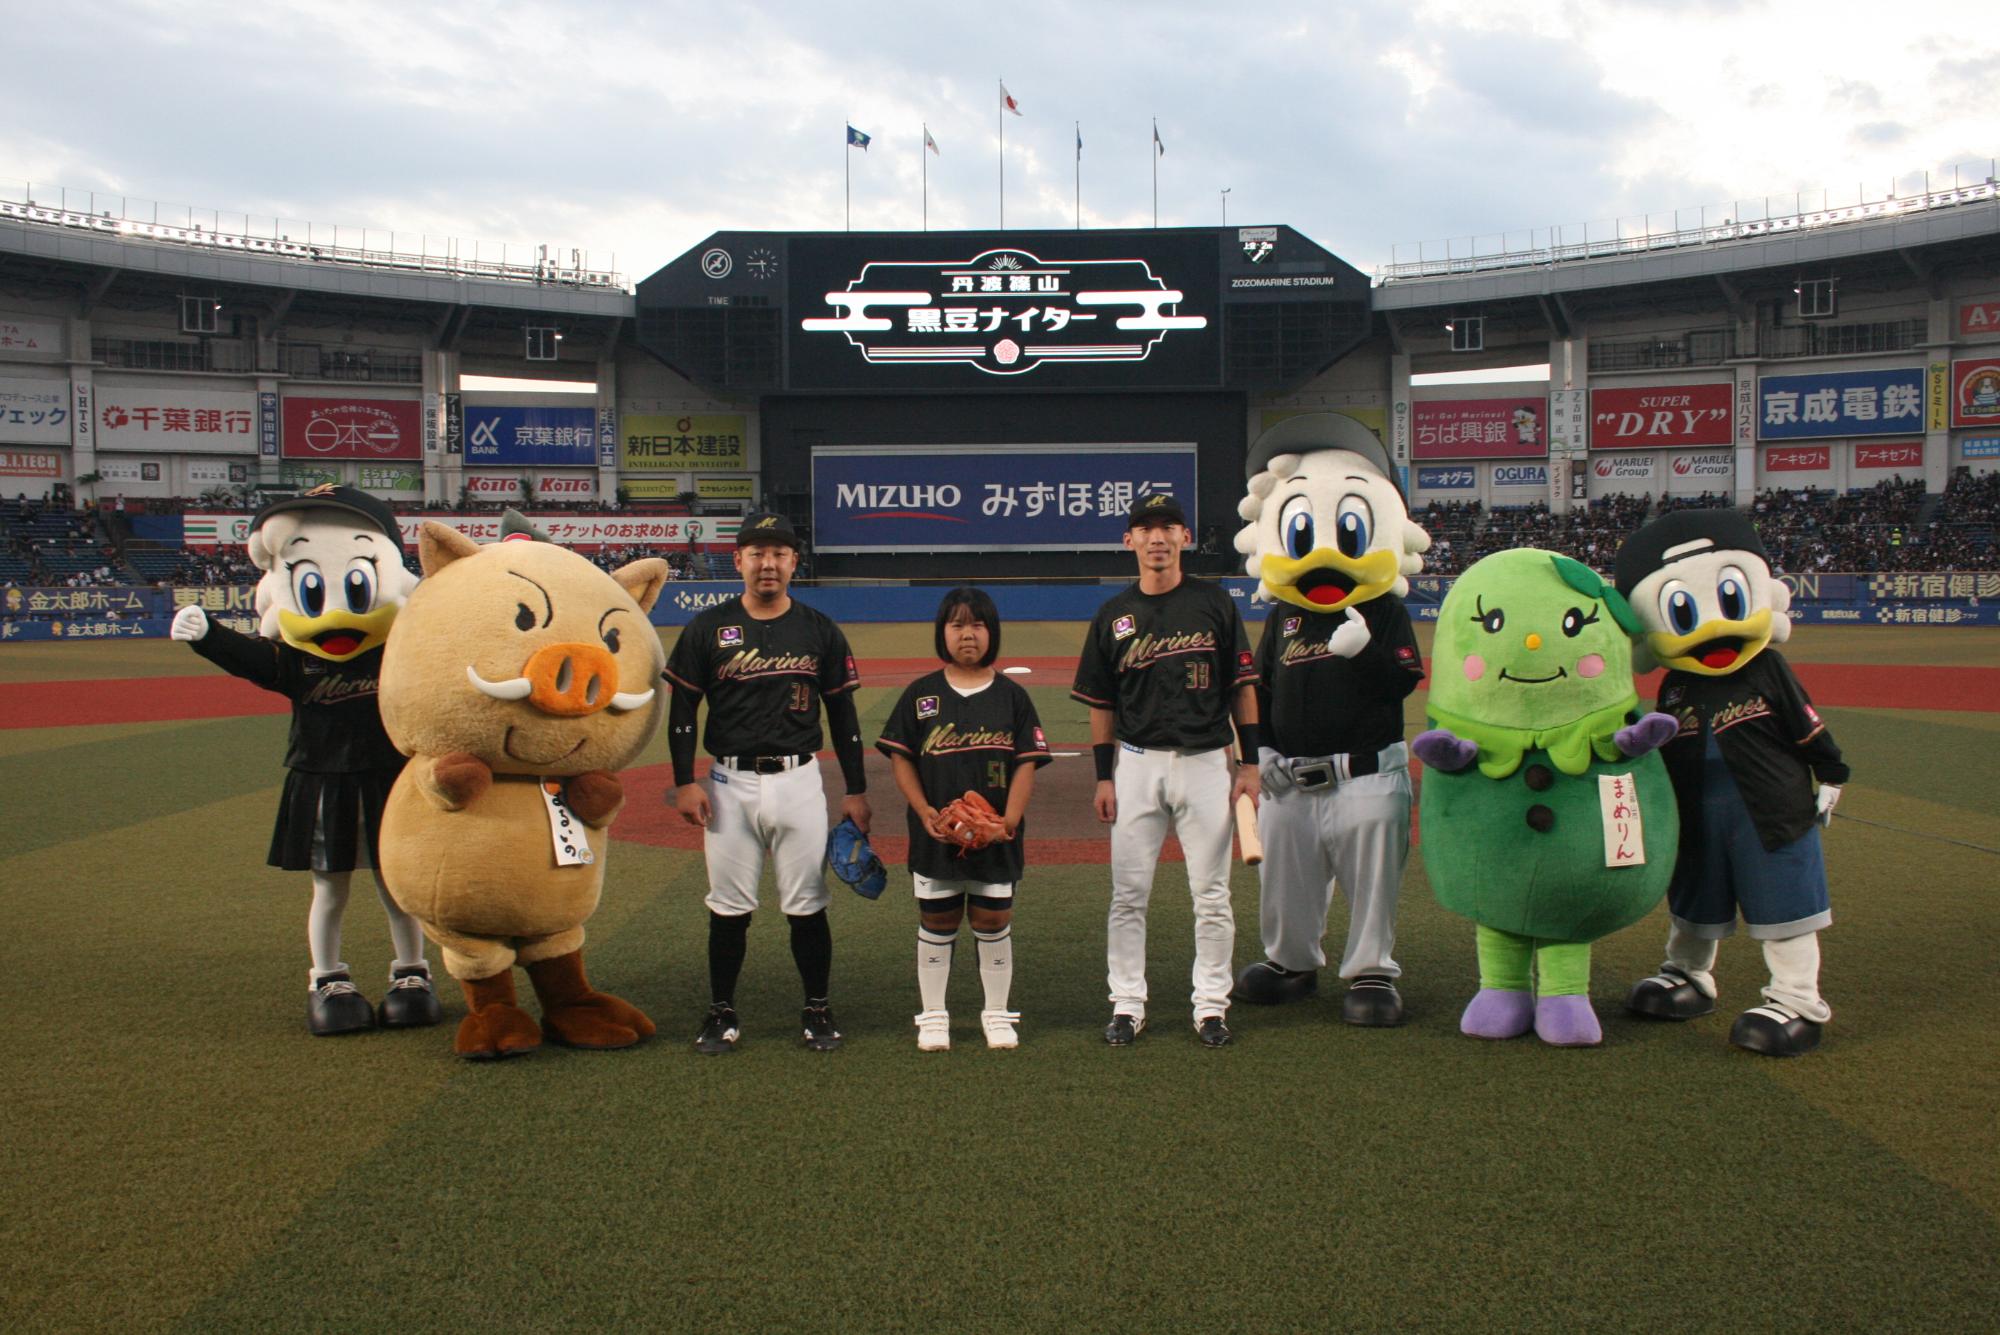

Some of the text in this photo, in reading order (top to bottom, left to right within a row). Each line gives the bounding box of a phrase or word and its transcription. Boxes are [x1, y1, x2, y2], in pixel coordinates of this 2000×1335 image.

[951, 275, 1060, 292] 丹波篠山
[1232, 276, 1334, 287] ZOZOMARINE STADIUM
[708, 296, 729, 305] TIME
[907, 306, 1098, 332] 黒豆ナイター
[1639, 395, 1691, 408] SUPER
[1739, 380, 1752, 426] 京成バス
[1763, 383, 1921, 425] 京成電鉄
[131, 407, 252, 434] 千葉銀行
[447, 394, 460, 453] アーキセプト
[514, 426, 593, 447] 京葉銀行
[1417, 421, 1508, 445] ちば興銀
[471, 446, 499, 455] BANK
[627, 434, 741, 457] 新日本建設
[689, 460, 740, 468] DEVELOPER
[1612, 457, 1654, 466] MARUEI
[1769, 454, 1826, 466] アーキセプト
[1859, 450, 1919, 463] アーキセプト
[1438, 471, 1474, 485] オグラ
[1495, 467, 1547, 481] OGURA
[1615, 465, 1649, 477] Group
[1694, 464, 1729, 475] Group
[836, 483, 963, 509] MIZUHO
[547, 523, 680, 538] チケットのお求めは
[1893, 574, 2000, 598] 新宿健診
[28, 590, 145, 611] 金太郎ホーム
[66, 622, 145, 636] 金太郎ホーム
[1118, 630, 1216, 673] Marines
[718, 647, 819, 681] Marines
[920, 722, 1014, 757] Marines
[987, 760, 1007, 789] 51
[1613, 778, 1635, 860] まめりん
